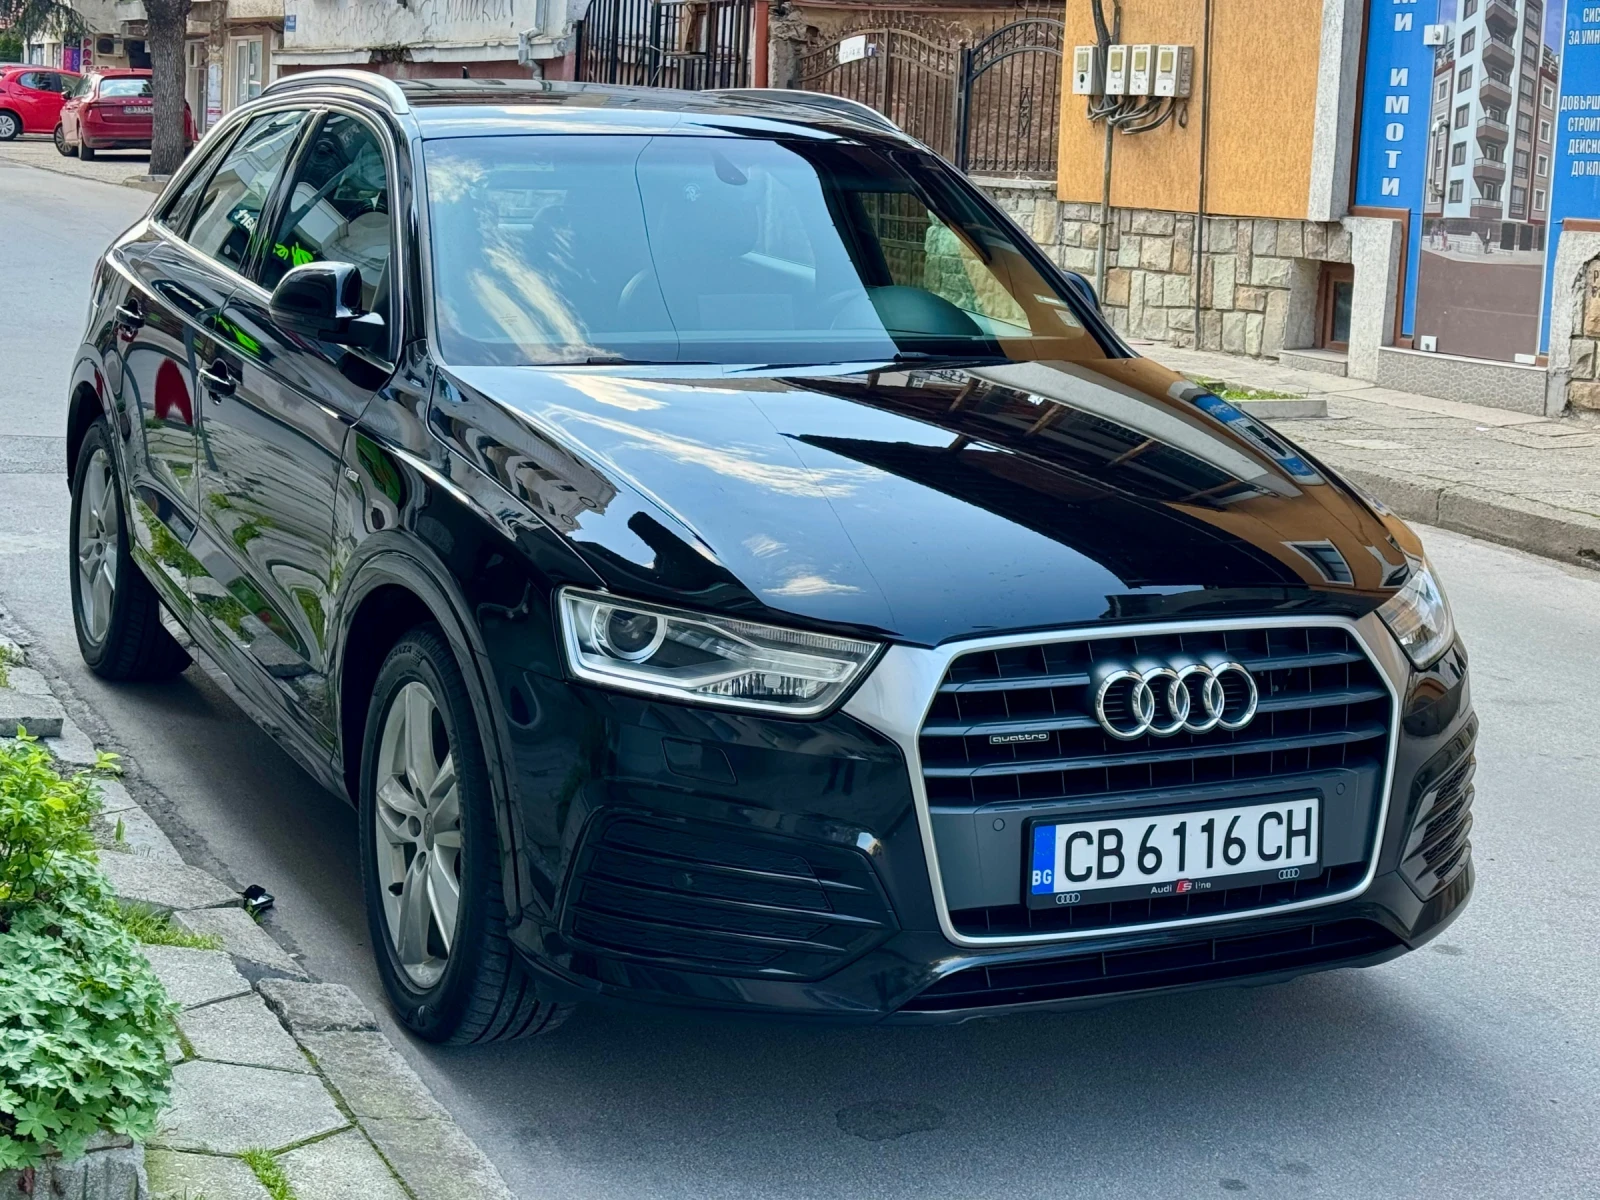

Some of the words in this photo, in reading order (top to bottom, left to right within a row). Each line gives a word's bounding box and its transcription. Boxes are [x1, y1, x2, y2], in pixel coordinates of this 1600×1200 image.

[1393, 0, 1417, 32] И
[1568, 30, 1580, 45] ЗА
[1381, 67, 1410, 197] ИМОТИ
[1571, 160, 1585, 177] ДО
[1586, 160, 1600, 176] КЛ
[992, 733, 1047, 743] quattro
[1032, 869, 1052, 886] BG
[1150, 884, 1173, 894] Audi
